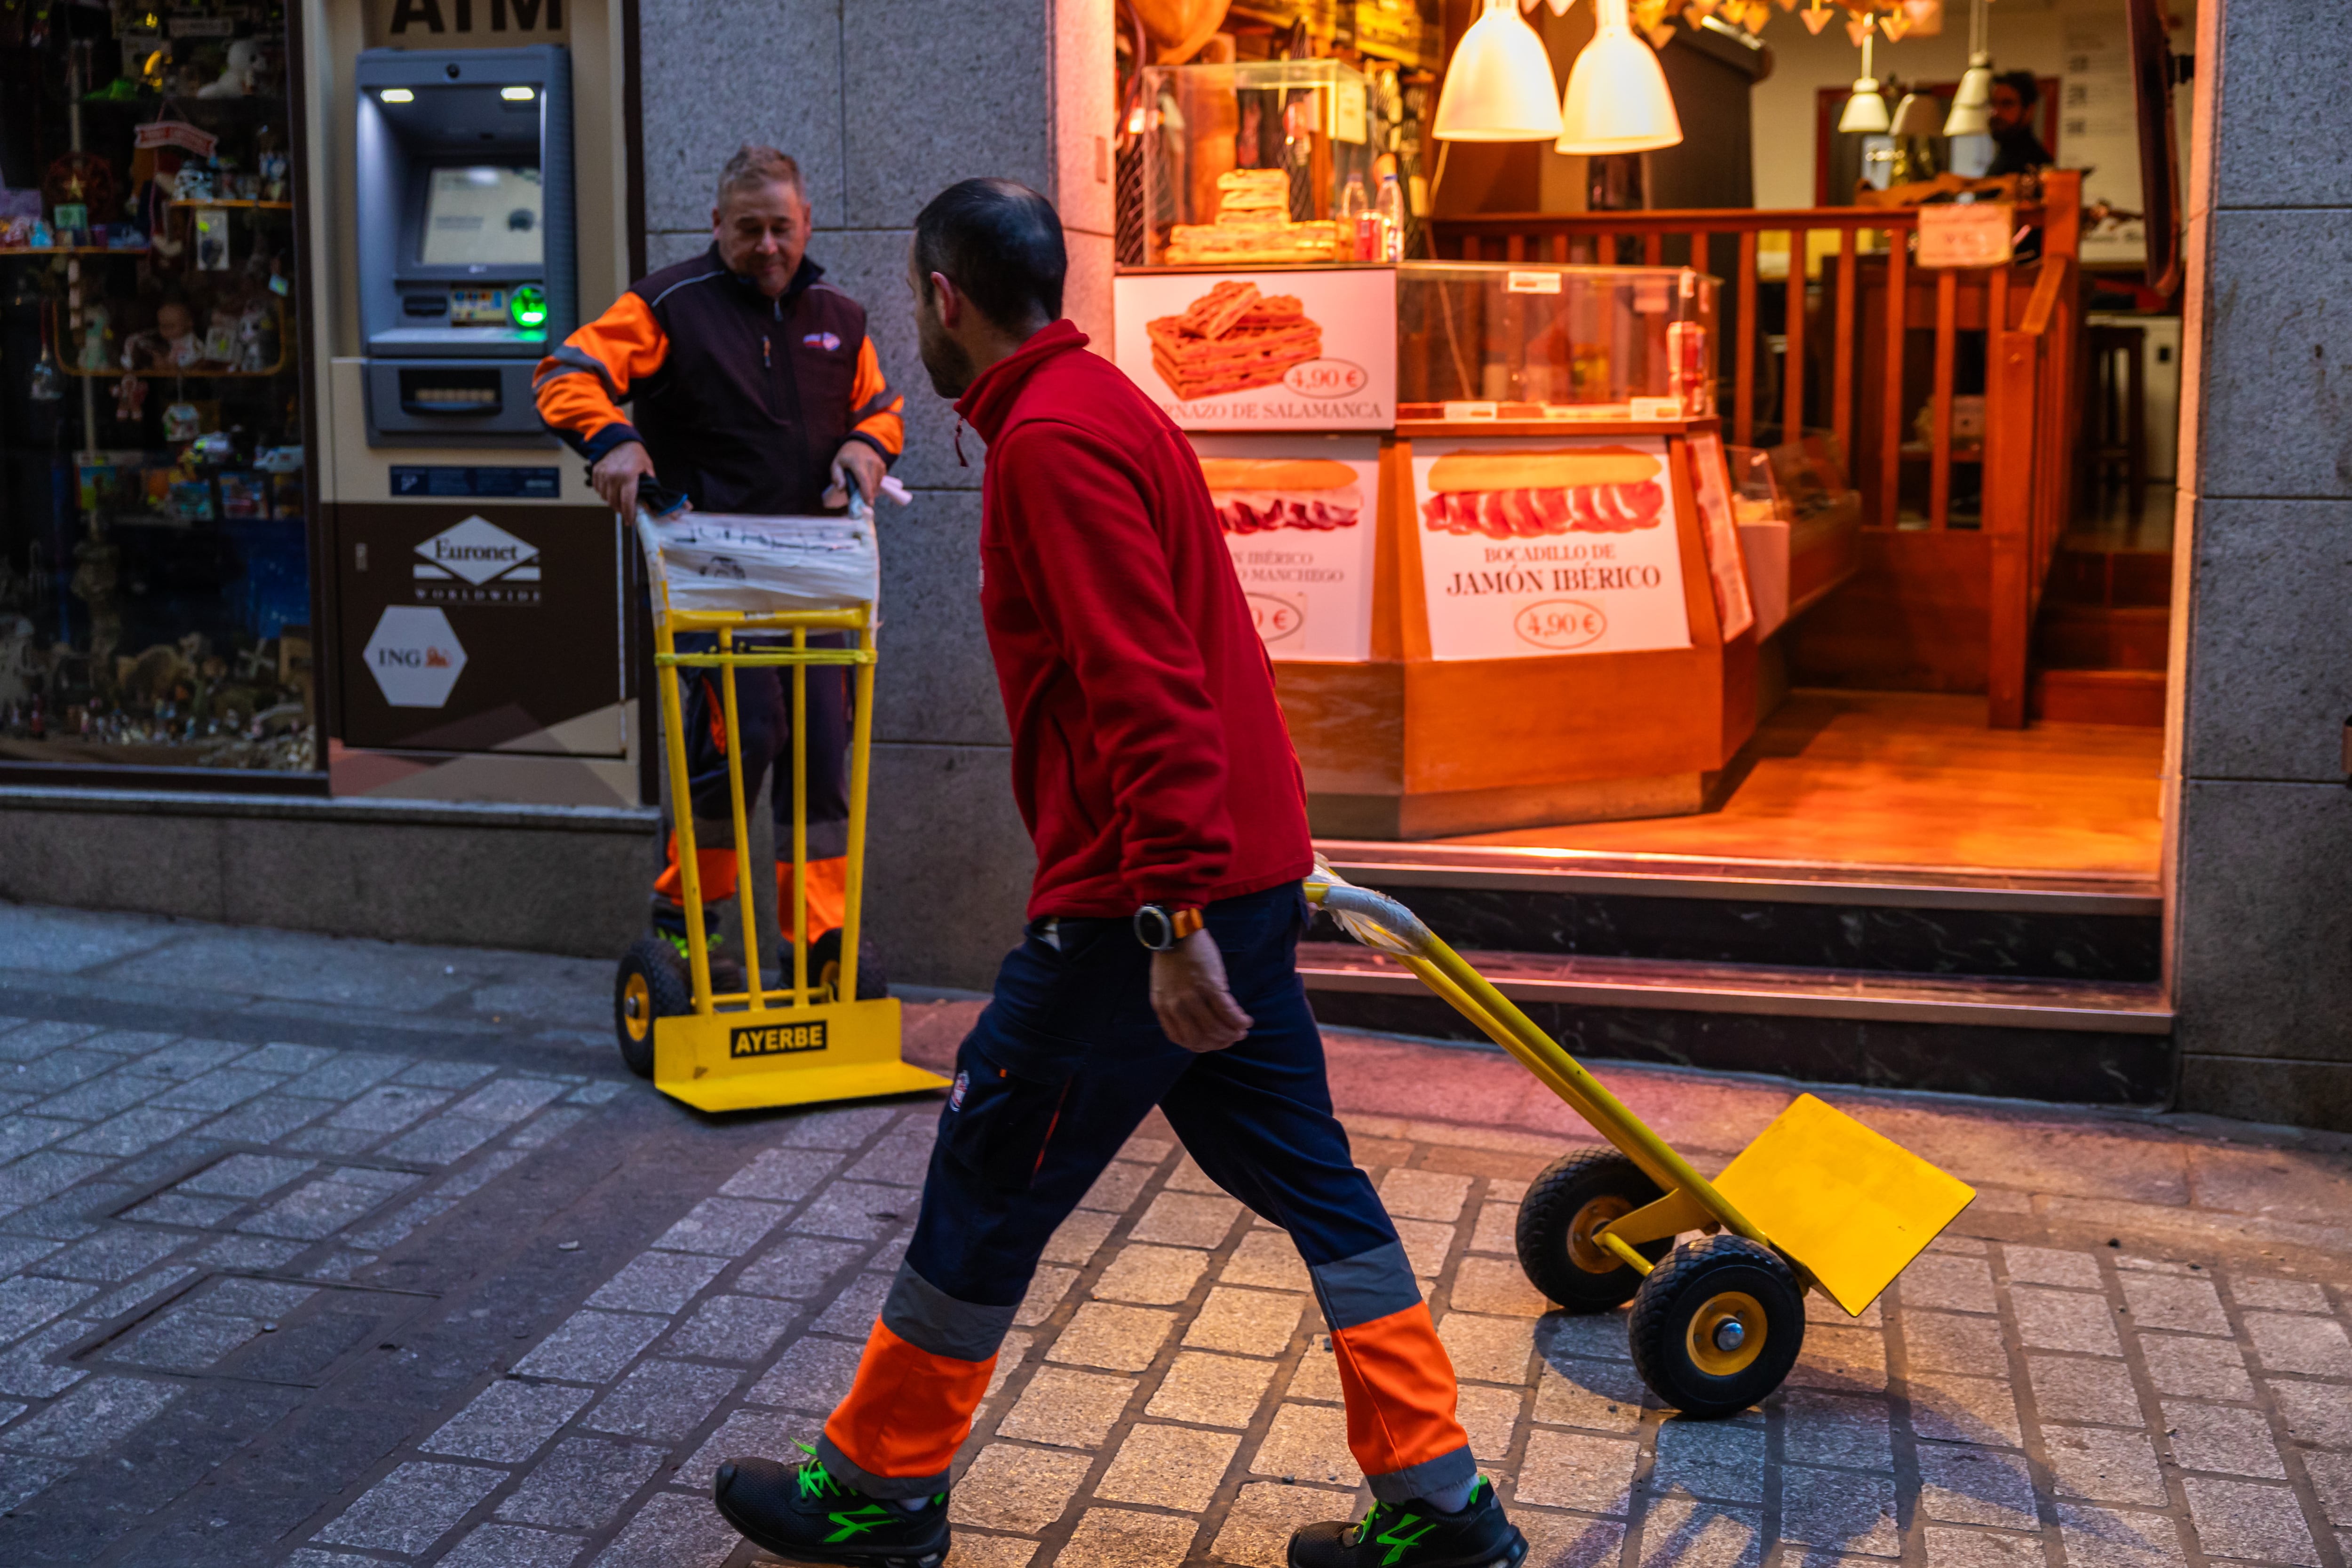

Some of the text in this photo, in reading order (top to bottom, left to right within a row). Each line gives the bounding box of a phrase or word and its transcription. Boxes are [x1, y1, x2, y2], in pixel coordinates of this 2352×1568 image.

[1292, 370, 1359, 391] 4,90 €
[1162, 402, 1382, 420] RNAZO DE SALAMANCA
[435, 539, 517, 560] Euronet
[1485, 543, 1616, 563] BOCADILLO DE
[1251, 568, 1344, 582] MANCHEGO
[1447, 561, 1661, 596] JAMÓN IBÉRICO
[1527, 612, 1598, 638] 4,90 €
[378, 649, 421, 668] ING
[735, 1025, 823, 1054] AYERBE
